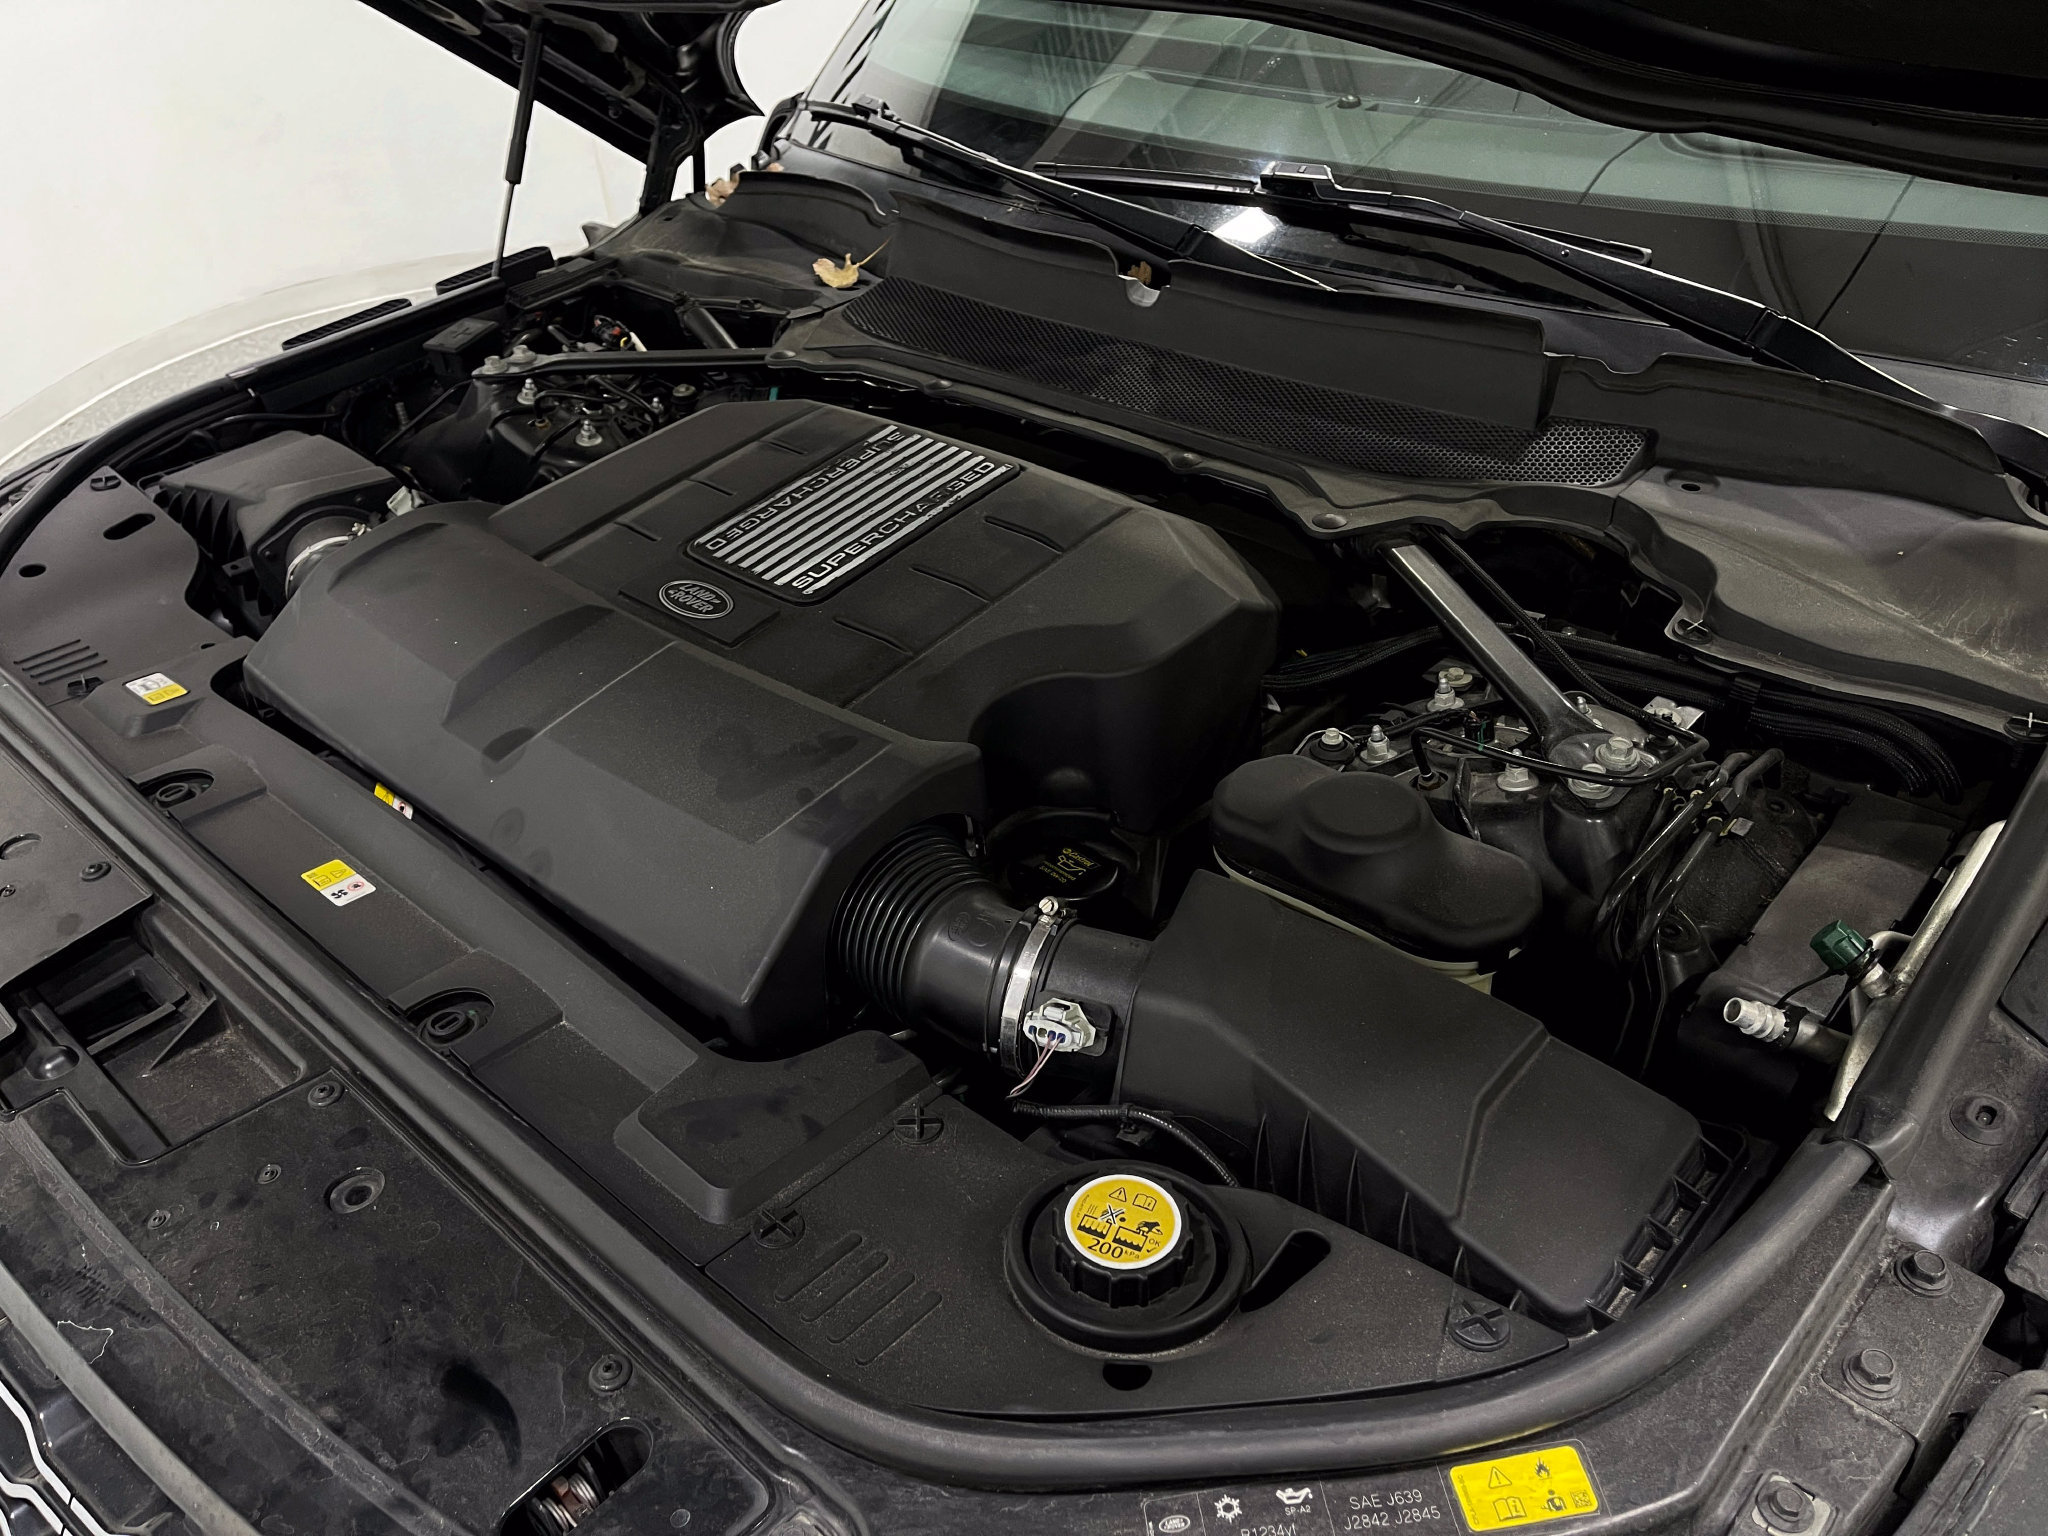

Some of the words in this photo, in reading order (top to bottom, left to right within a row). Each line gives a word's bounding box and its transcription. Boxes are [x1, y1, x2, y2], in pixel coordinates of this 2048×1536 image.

[706, 431, 905, 551] SUPERCHARGED
[791, 461, 996, 590] SUPERCHARGED
[670, 590, 714, 613] ROVER
[680, 584, 716, 601] LAND
[1087, 1237, 1124, 1259] 200
[1124, 1250, 1140, 1260] kPa
[1148, 1238, 1161, 1248] OK
[1349, 1493, 1383, 1510] SAE
[1386, 1489, 1423, 1506] J639
[1344, 1511, 1390, 1531] J2842
[1394, 1505, 1441, 1525] J2845
